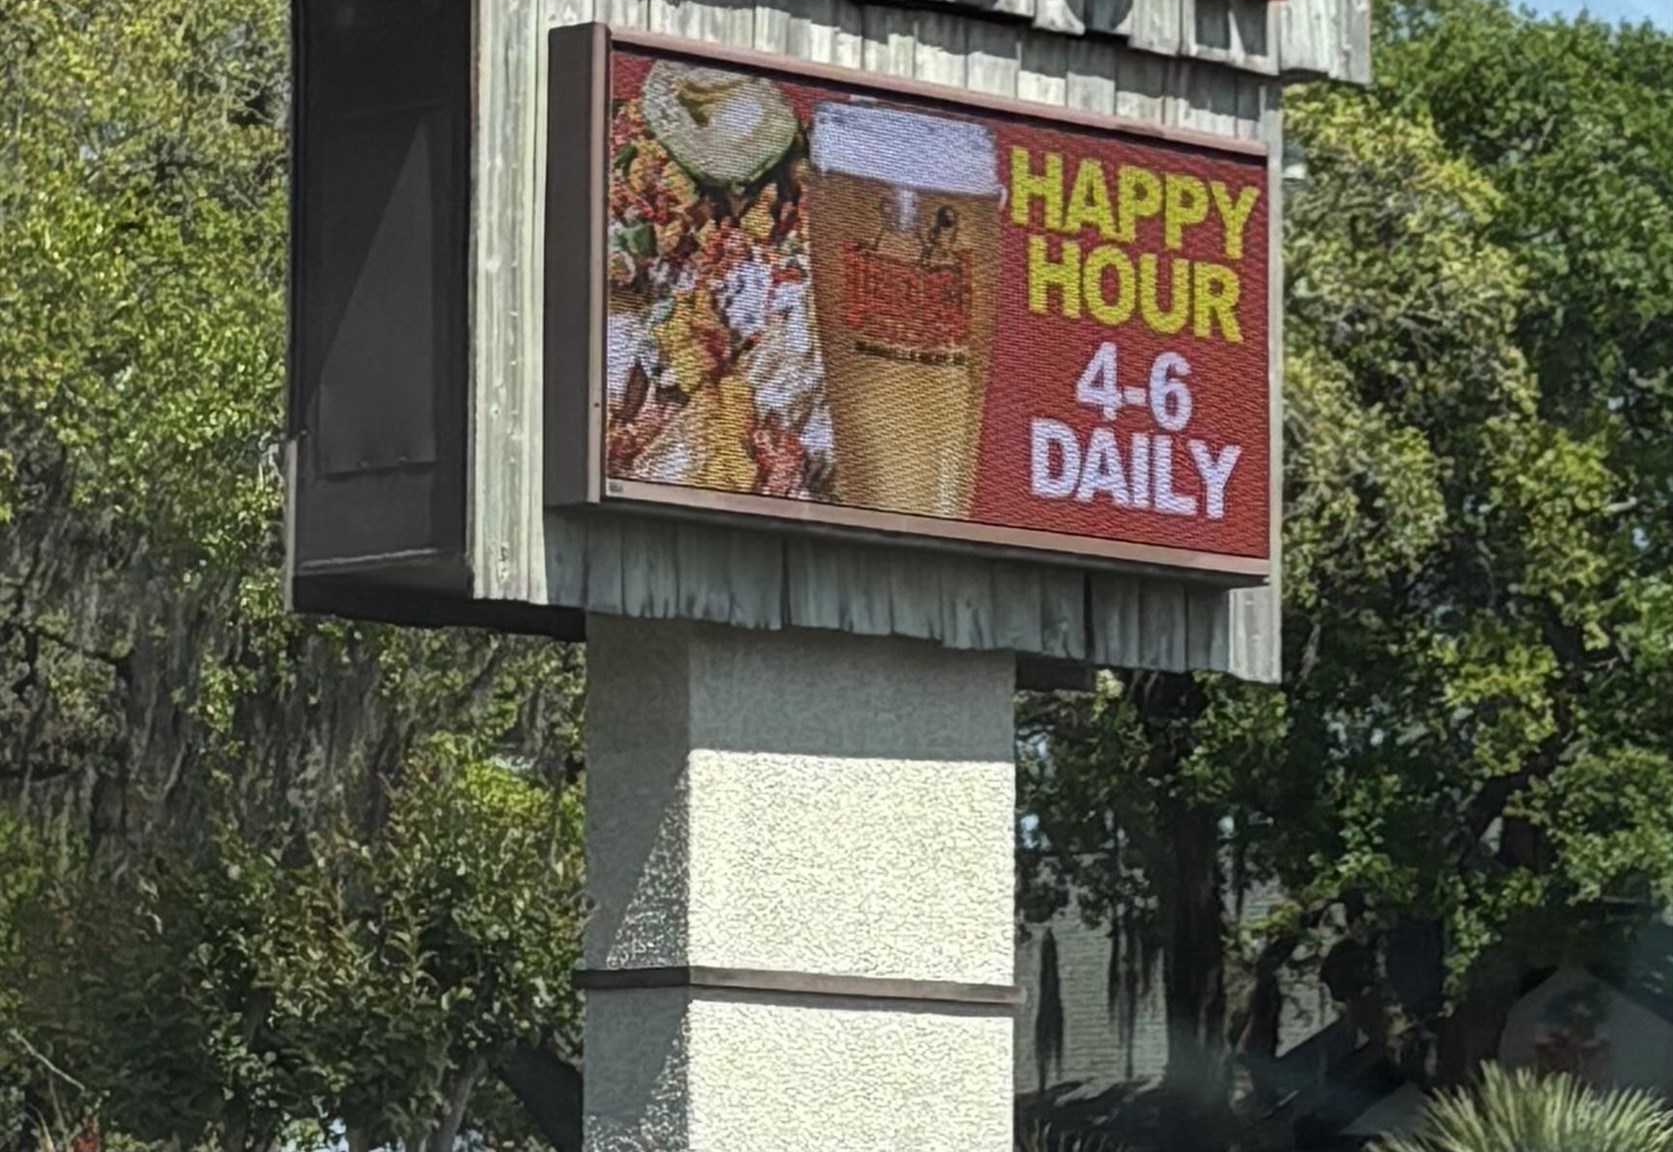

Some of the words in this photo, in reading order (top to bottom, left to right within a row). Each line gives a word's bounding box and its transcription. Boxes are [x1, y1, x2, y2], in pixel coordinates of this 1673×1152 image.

[1009, 145, 1262, 260] HAPPY
[1026, 234, 1246, 344] HOUR
[1074, 340, 1194, 432] 4-6
[1028, 415, 1244, 520] DAILY
